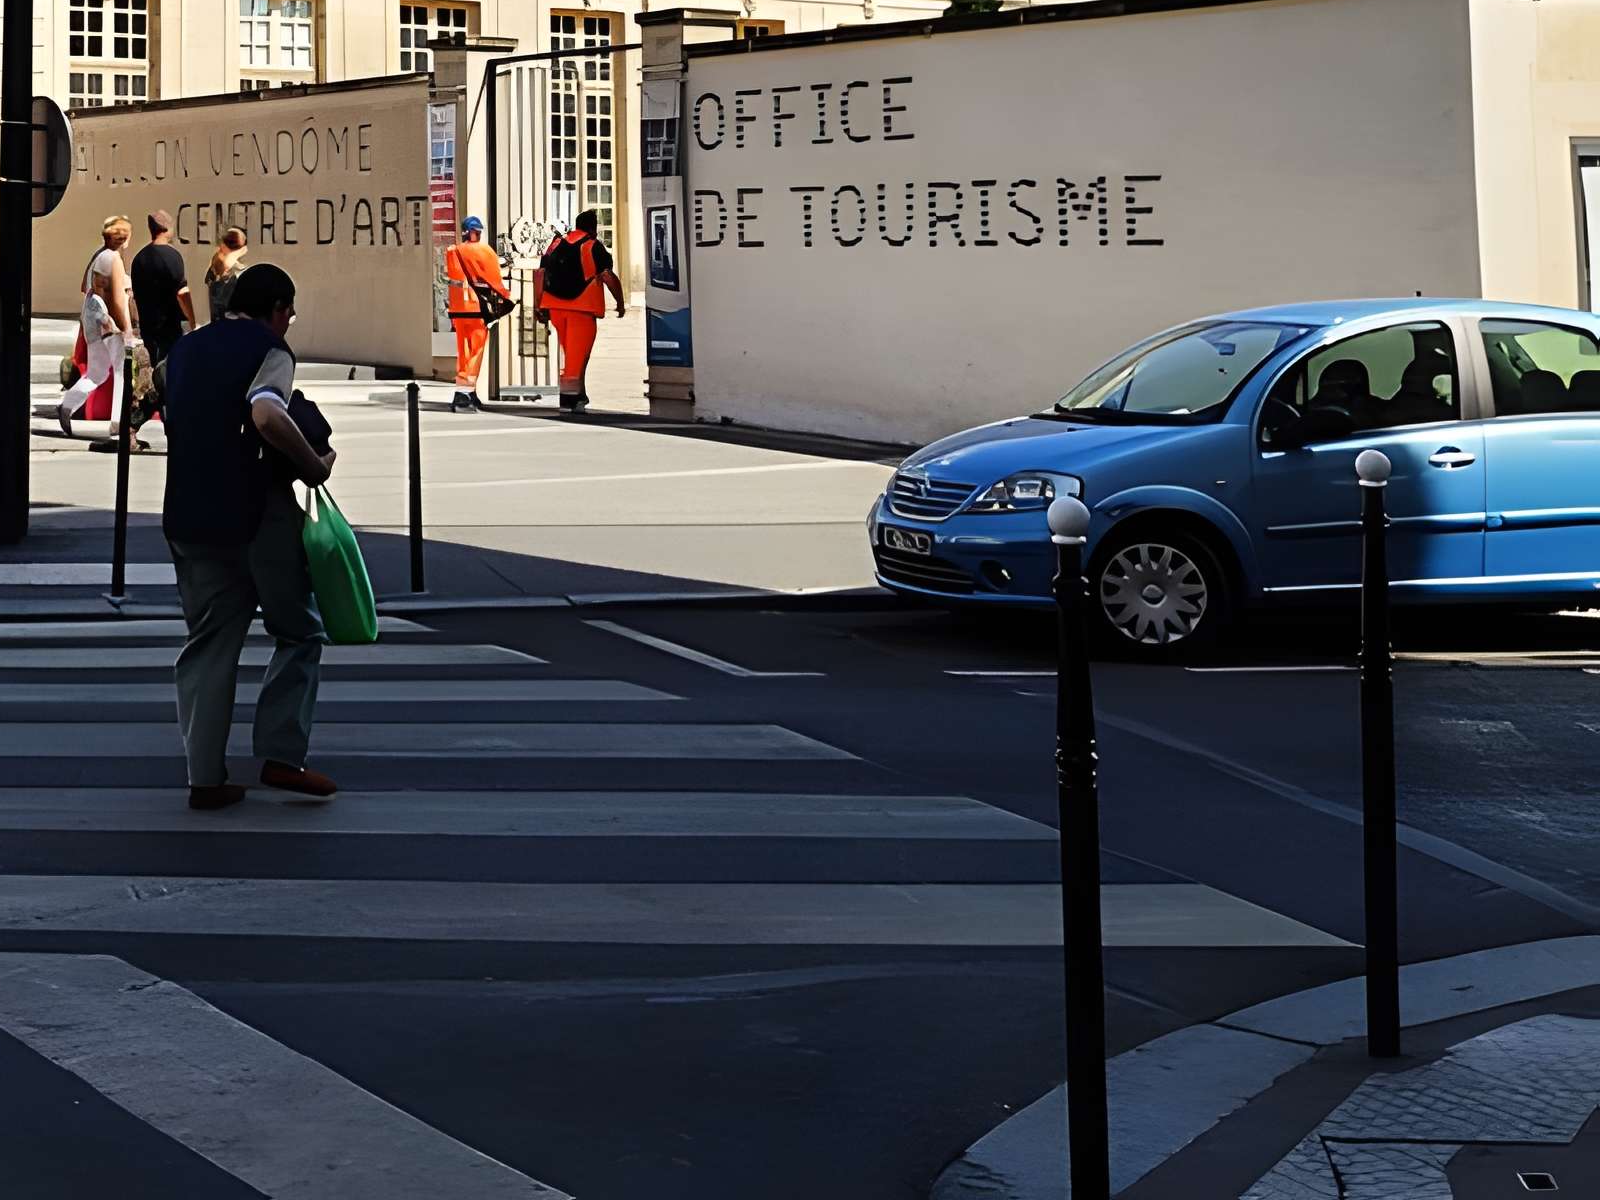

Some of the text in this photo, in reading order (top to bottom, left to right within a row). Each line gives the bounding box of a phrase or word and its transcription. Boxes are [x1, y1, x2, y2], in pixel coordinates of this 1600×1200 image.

[693, 76, 915, 150] OFFICE
[208, 117, 373, 177] VENDÔME
[177, 194, 429, 246] CENTRE D'ART
[694, 175, 1165, 249] DE TOURISME
